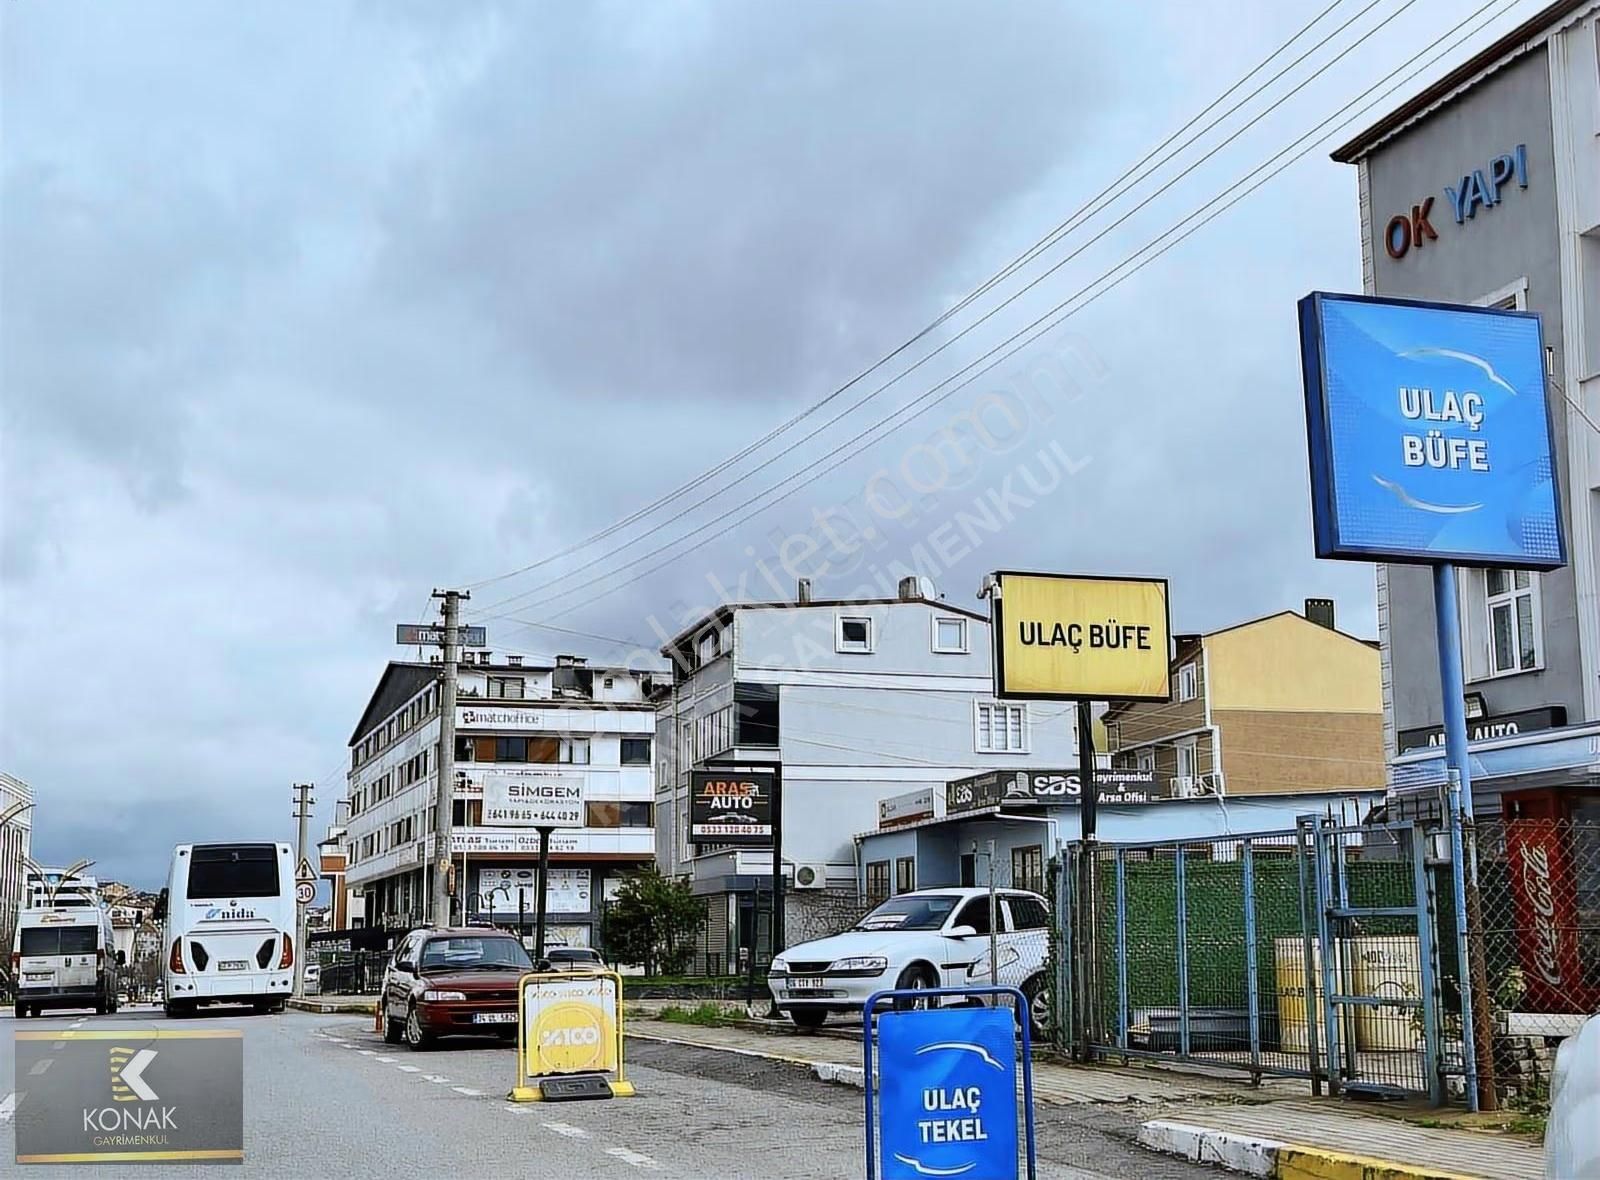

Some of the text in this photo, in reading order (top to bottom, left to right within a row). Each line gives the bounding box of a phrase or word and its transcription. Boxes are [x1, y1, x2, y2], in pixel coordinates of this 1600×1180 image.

[1385, 143, 1528, 259] OK YAPI
[1399, 387, 1484, 432] ULAÇ
[1403, 430, 1490, 472] BÜFE
[1019, 618, 1151, 654] ULAÇ BÜFE
[1092, 771, 1153, 784] ayrimenkul
[508, 782, 580, 798] SİMGEM
[703, 781, 749, 796] ARAS
[1099, 791, 1147, 803] Arsa Ofisi
[710, 796, 753, 809] AUTO
[298, 887, 311, 899] 30
[923, 1087, 981, 1114] ULAÇ
[918, 1118, 988, 1143] TEKEL
